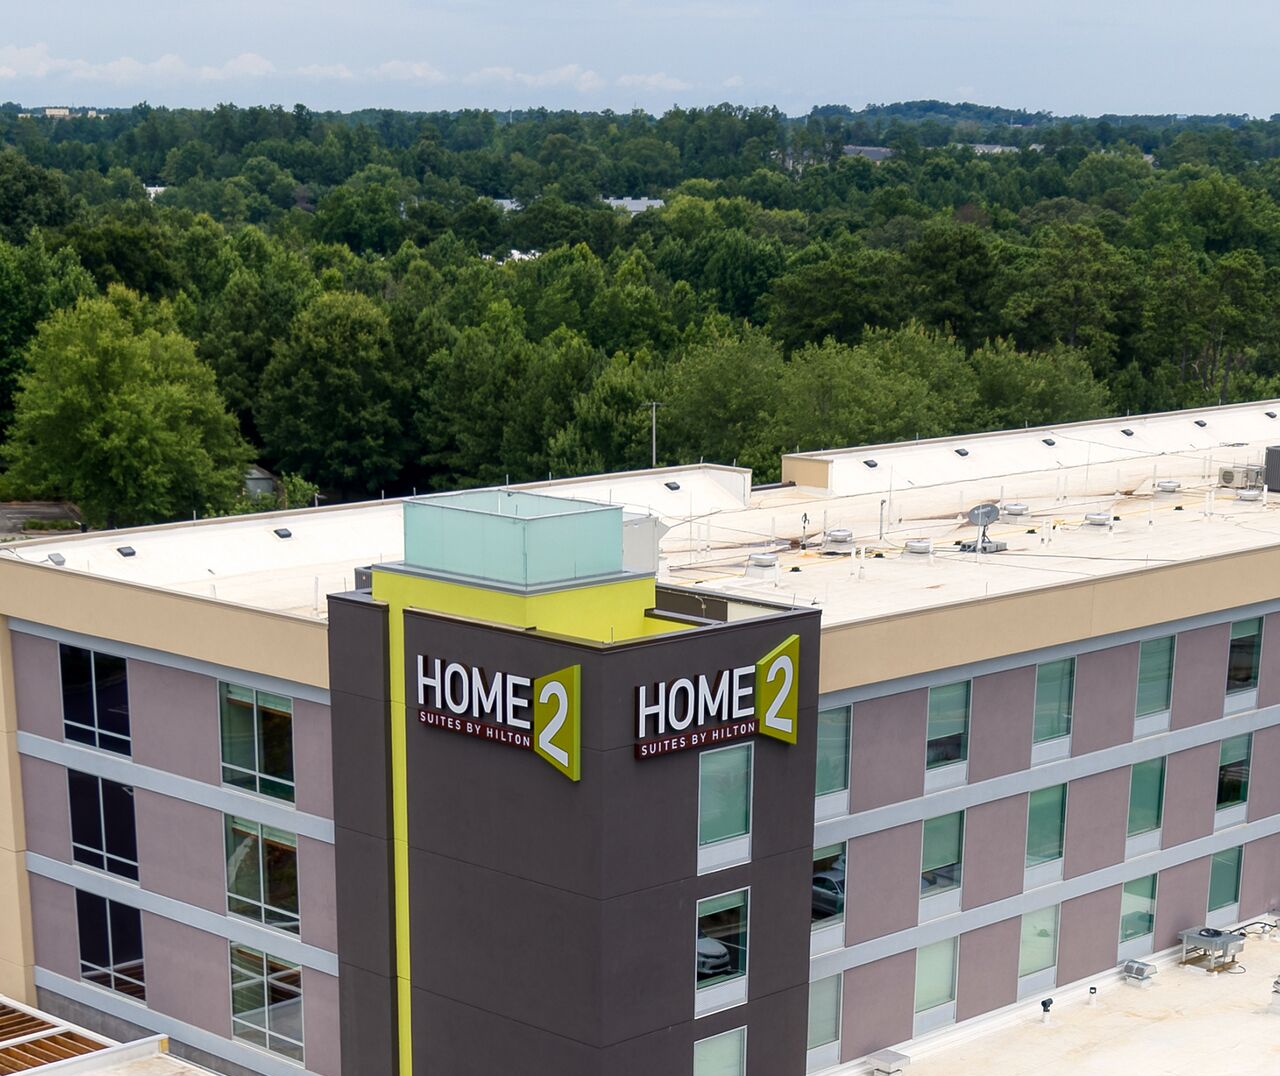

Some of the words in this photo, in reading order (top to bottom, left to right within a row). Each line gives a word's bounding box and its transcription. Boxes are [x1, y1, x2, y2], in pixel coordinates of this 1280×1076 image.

[417, 654, 531, 730] HOME
[538, 680, 569, 768] 2
[639, 665, 756, 739] HOME
[765, 655, 794, 733] 2
[420, 711, 462, 731] SUITES
[466, 722, 481, 735] BY
[486, 727, 531, 747] HILTON
[641, 736, 686, 756] SUITES
[691, 732, 707, 745] BY
[712, 721, 756, 741] HILTON
